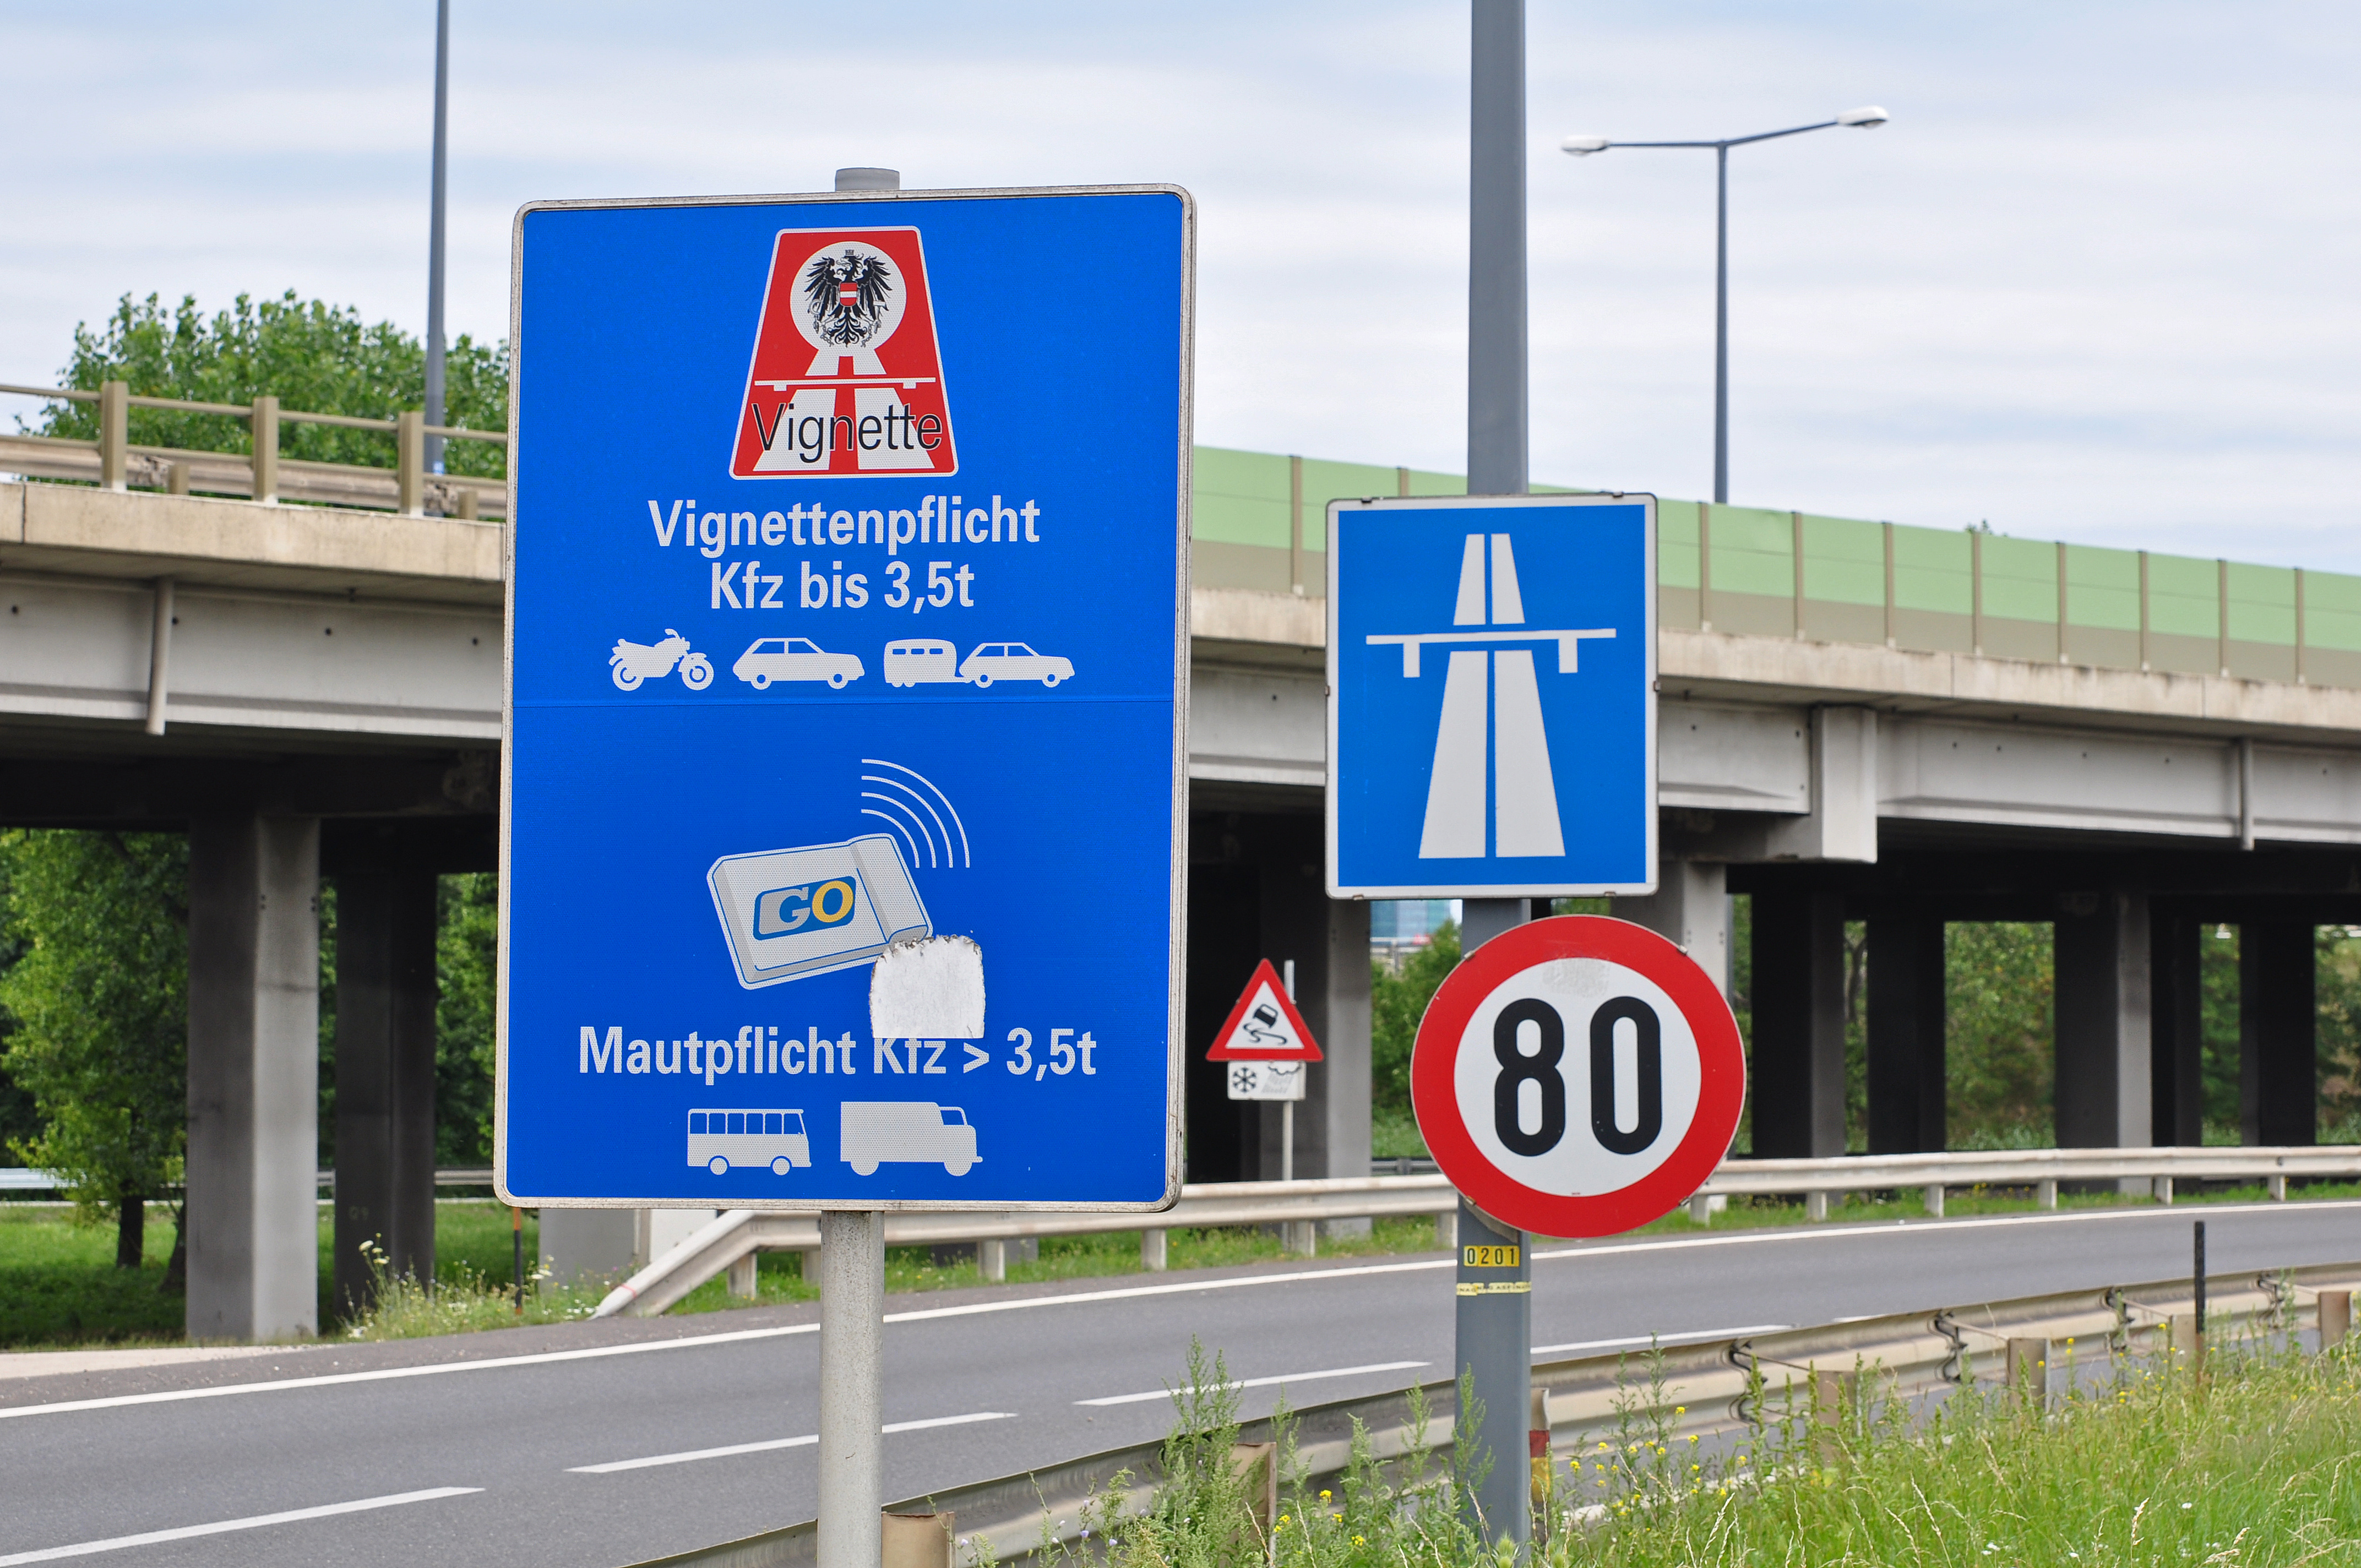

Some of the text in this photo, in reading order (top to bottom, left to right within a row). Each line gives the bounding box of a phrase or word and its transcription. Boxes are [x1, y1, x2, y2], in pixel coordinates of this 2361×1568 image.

[751, 403, 943, 464] Vignette
[647, 494, 1041, 558] Vignettenpflicht
[710, 560, 975, 614] Kfz bis 3,5t
[777, 879, 855, 924] GO
[578, 1025, 856, 1086] Mautpflicht
[1006, 1027, 1097, 1081] 3,5t
[1493, 995, 1662, 1157] 80
[1467, 1247, 1515, 1265] 0201
